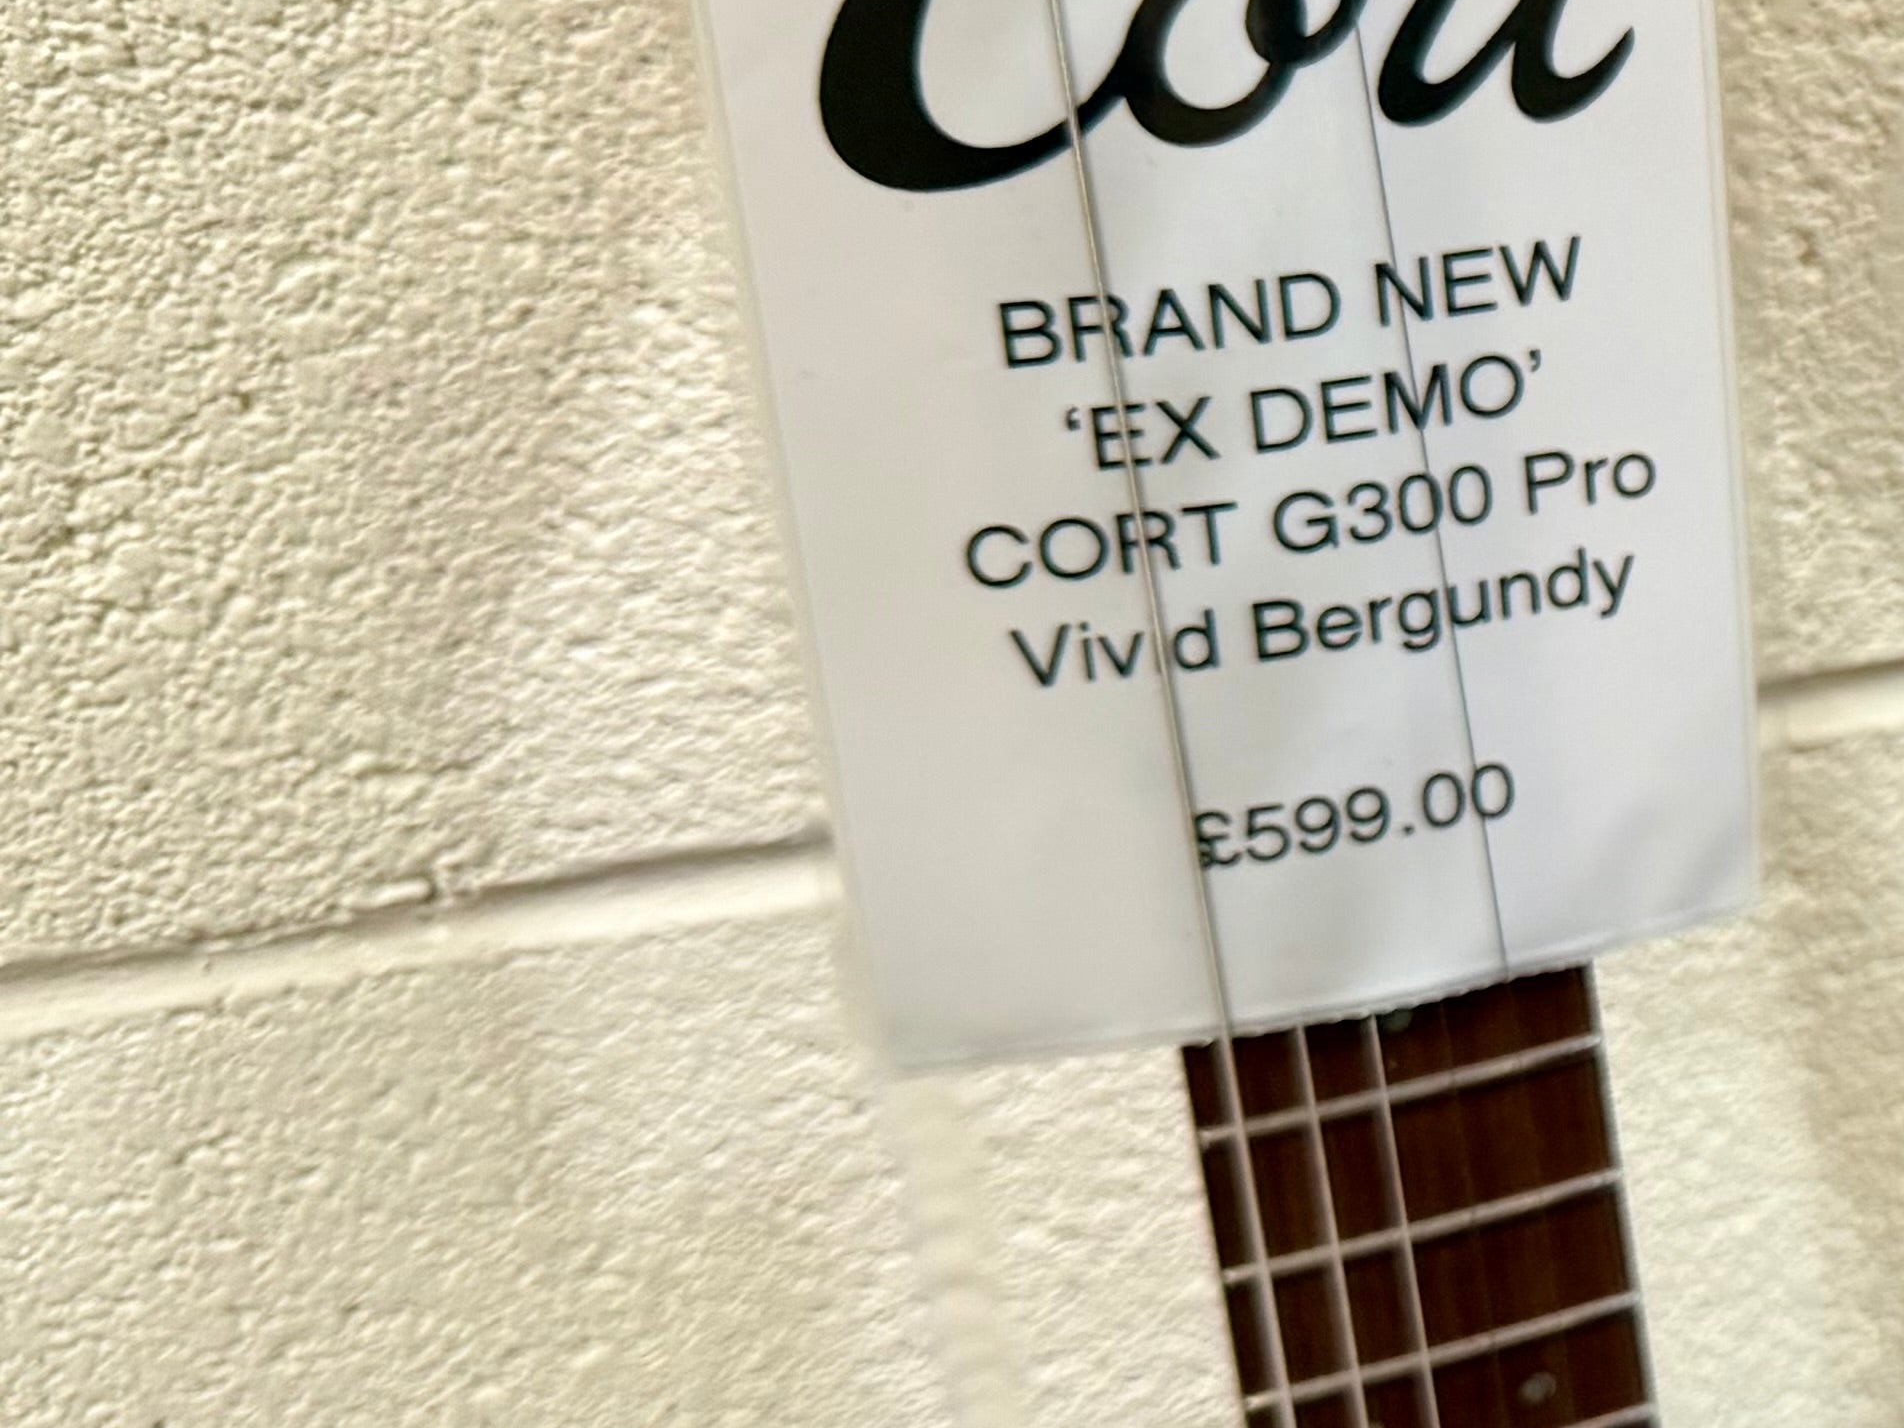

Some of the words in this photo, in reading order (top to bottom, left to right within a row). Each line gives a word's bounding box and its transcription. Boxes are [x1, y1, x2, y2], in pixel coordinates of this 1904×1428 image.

[997, 272, 1343, 369] BRAND
[1374, 235, 1583, 327] NEW
[965, 502, 1238, 589] CORT
[1272, 464, 1493, 553] G300
[1523, 450, 1657, 515] Pro
[1008, 608, 1220, 687] Vivd
[1251, 547, 1635, 663] Bergundy
[1194, 762, 1516, 871] £599.00
